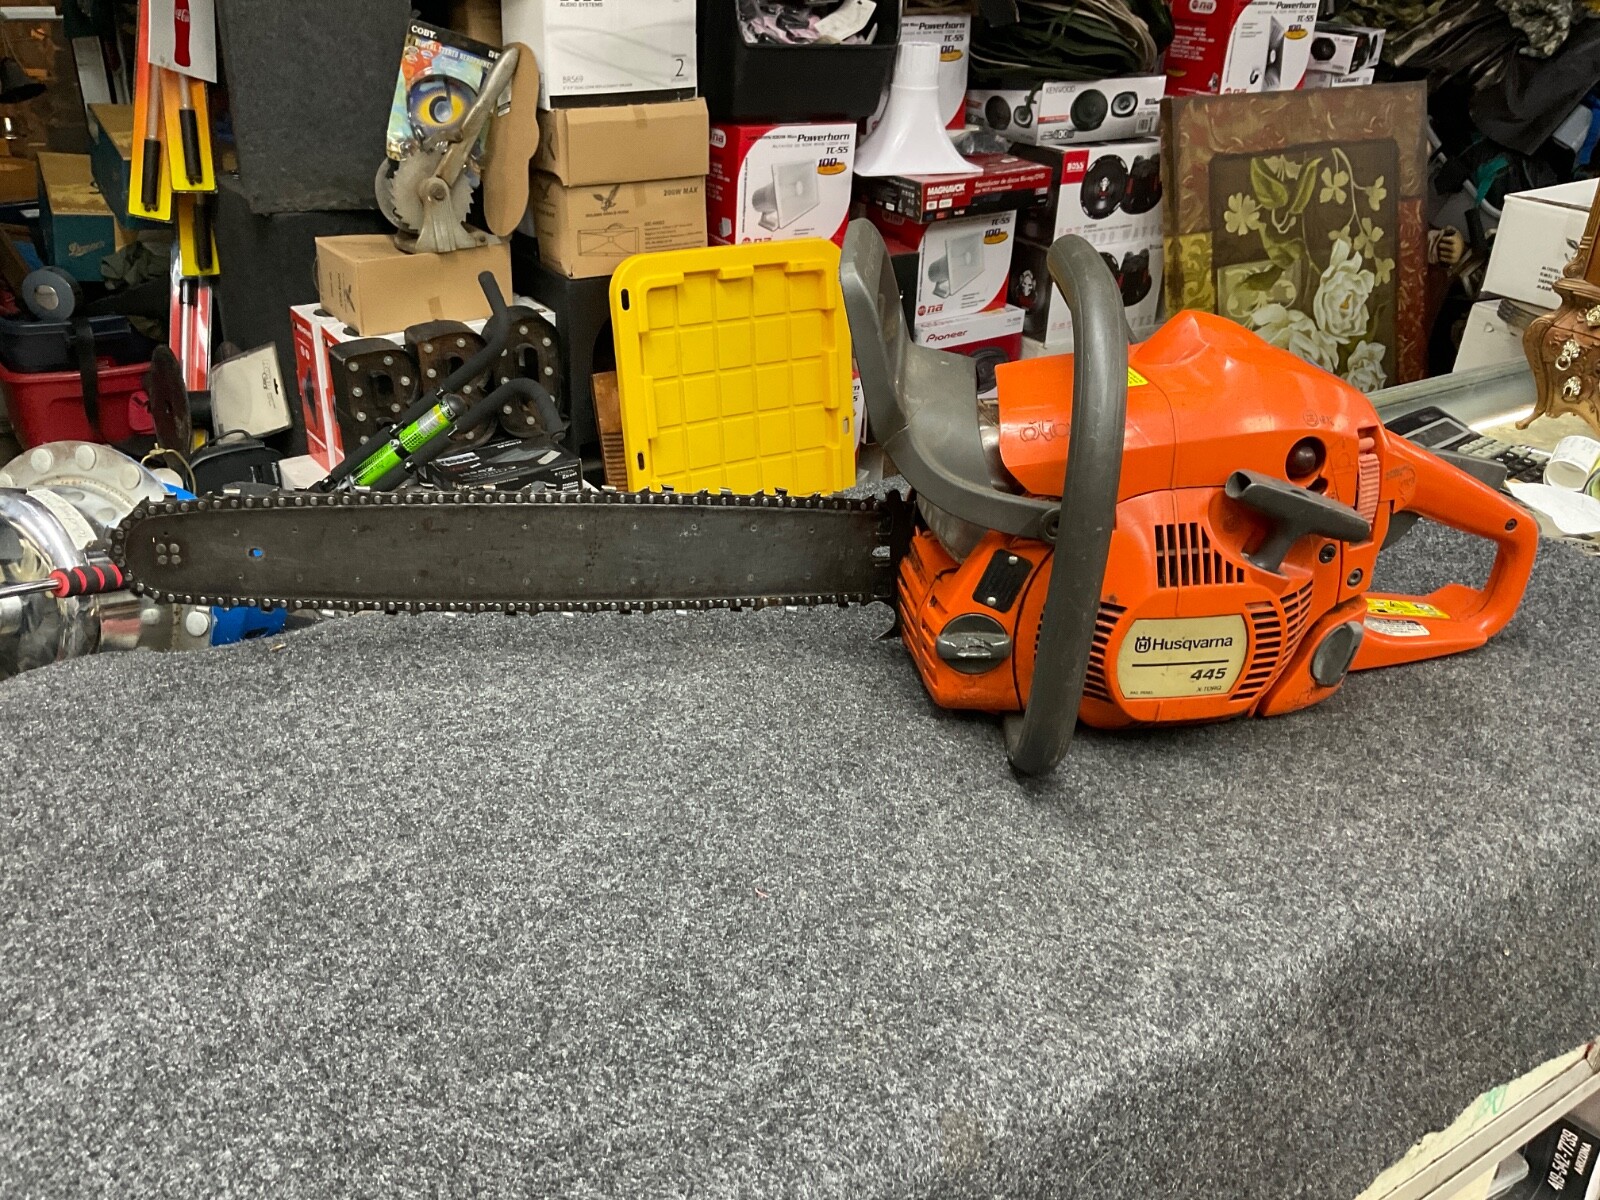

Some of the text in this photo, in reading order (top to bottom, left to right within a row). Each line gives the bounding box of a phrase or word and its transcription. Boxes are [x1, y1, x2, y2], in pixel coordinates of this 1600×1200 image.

[1275, 1, 1317, 10] Powerhorn
[918, 21, 966, 30] Powerhorn
[411, 25, 436, 39] COBY
[941, 45, 955, 54] 00
[675, 58, 685, 77] 2
[1045, 85, 1076, 94] KENWOOD
[797, 133, 850, 142] Powerhorn
[818, 157, 838, 168] 100
[1066, 162, 1084, 170] BOSS
[683, 186, 699, 194] MAX
[927, 183, 966, 196] MAGNAVOX
[926, 330, 968, 343] Pioneer
[1152, 636, 1233, 651] Husqvarna
[1190, 667, 1227, 681] 445
[1547, 1128, 1579, 1190] 419-542-7739
[1573, 1142, 1592, 1176] ARIZONA
